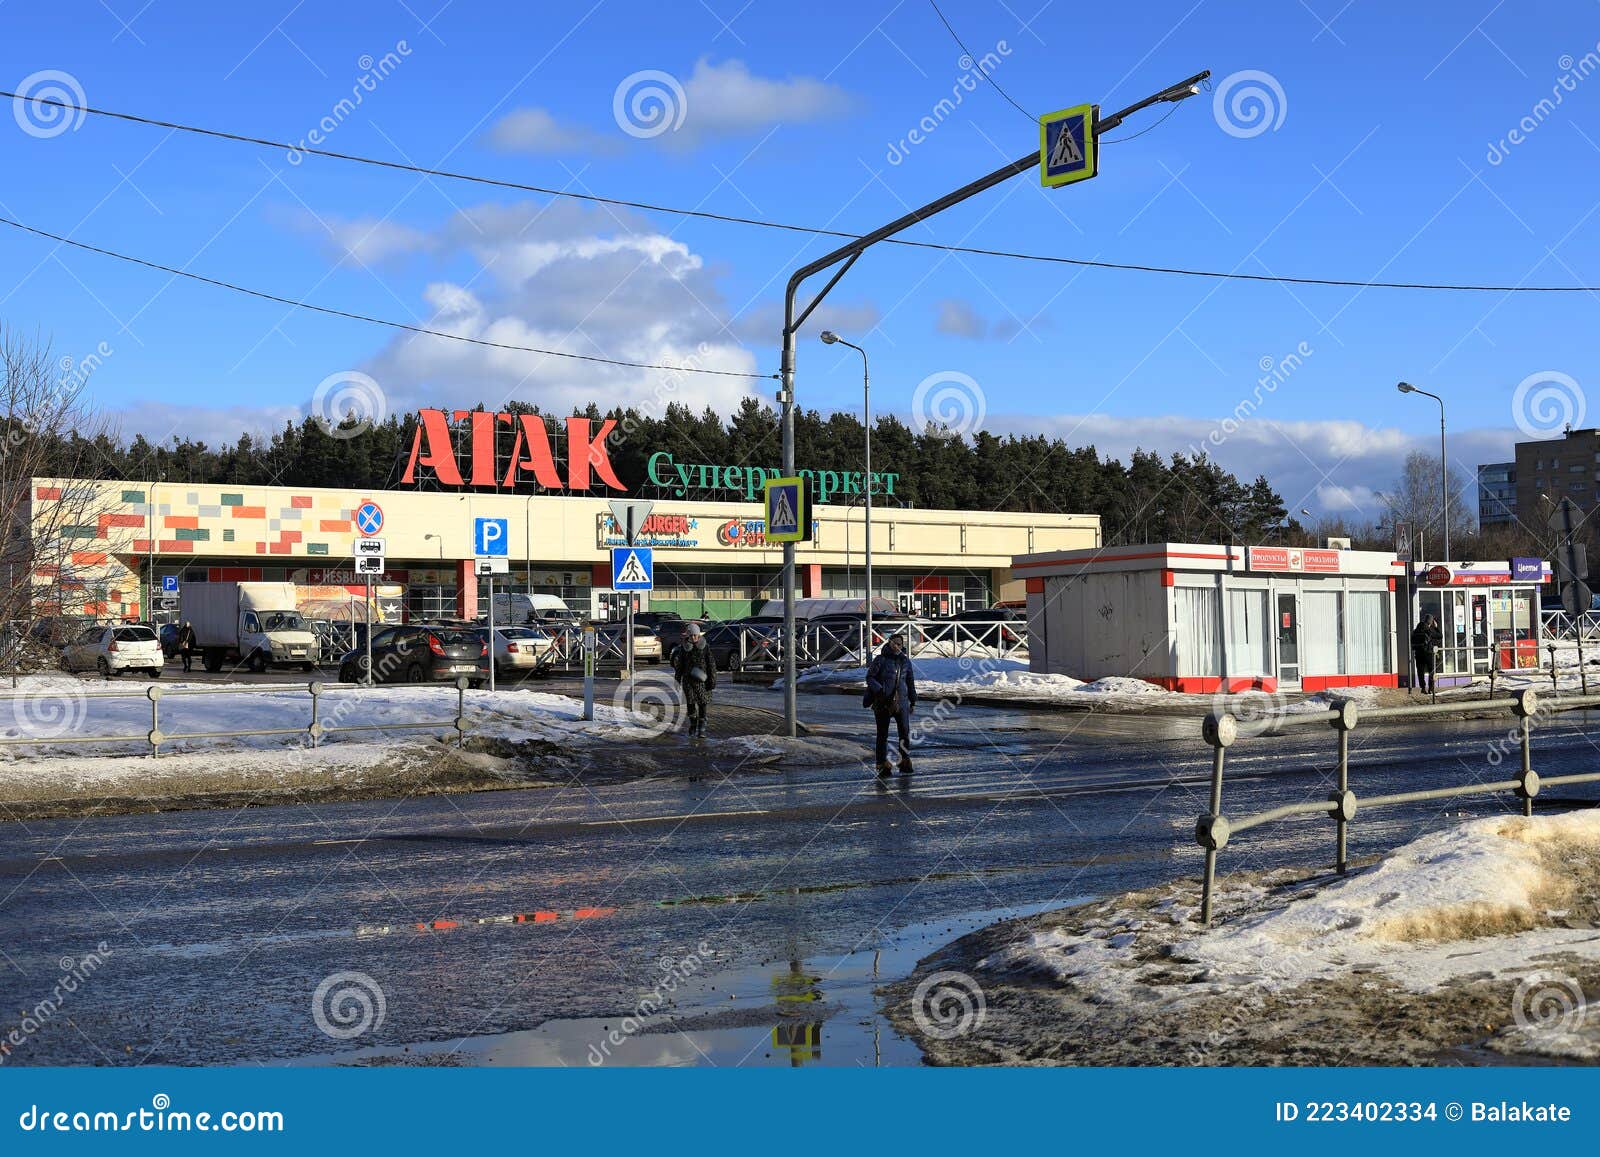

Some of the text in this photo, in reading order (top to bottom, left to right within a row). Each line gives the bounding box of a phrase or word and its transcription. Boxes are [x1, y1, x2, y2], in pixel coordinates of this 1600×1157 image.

[401, 408, 628, 491] АТАК
[483, 521, 502, 553] P
[1252, 554, 1287, 563] ПРОДУКТЫ
[1517, 563, 1538, 573] Цветы
[167, 577, 176, 590] P
